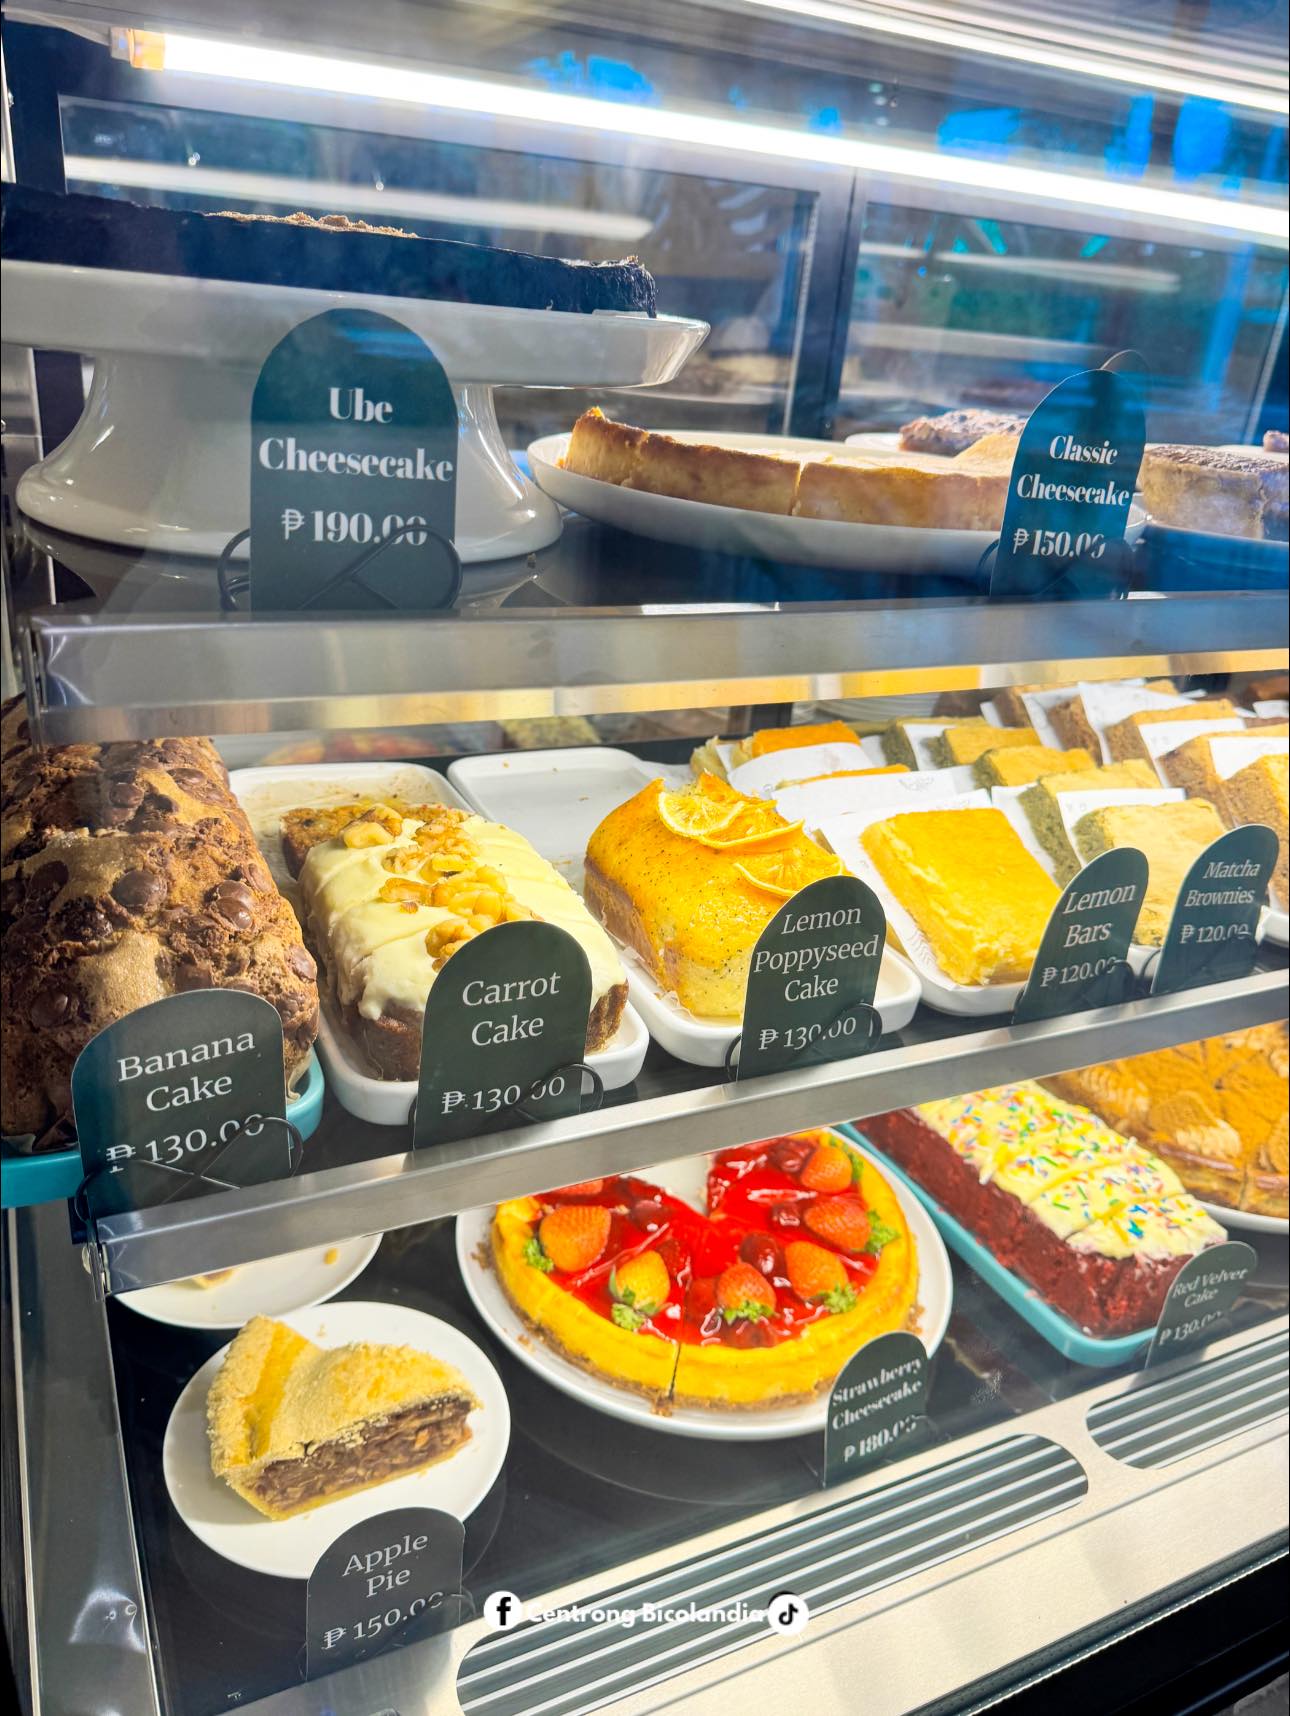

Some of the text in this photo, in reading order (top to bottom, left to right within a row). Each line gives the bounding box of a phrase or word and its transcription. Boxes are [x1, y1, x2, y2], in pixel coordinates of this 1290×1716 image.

[329, 386, 394, 424] Ube
[258, 437, 454, 482] Cheesecake
[1049, 435, 1119, 465] Classic
[1016, 473, 1131, 507] Cheesecake
[311, 510, 429, 546] 190.00
[1202, 859, 1261, 880] Matcha
[1062, 883, 1138, 915] Lemon
[1184, 886, 1256, 908] Brownies
[781, 907, 863, 936] Lemon
[1063, 922, 1114, 948] Bars
[753, 934, 880, 976] Poppyseed
[462, 971, 562, 1008] Carrot
[784, 974, 840, 1004] Cake
[471, 1014, 545, 1047] Cake
[116, 1031, 257, 1083] Banana
[145, 1074, 233, 1113] Cake
[472, 1075, 566, 1114] 13000
[144, 1112, 265, 1164] 130.00
[1172, 1275, 1201, 1299] Red
[1183, 1287, 1219, 1308] Cake
[832, 1357, 922, 1407] Strawberry
[831, 1380, 923, 1431] Cheesecake
[341, 1534, 429, 1577] Apple
[365, 1569, 411, 1599] Pie
